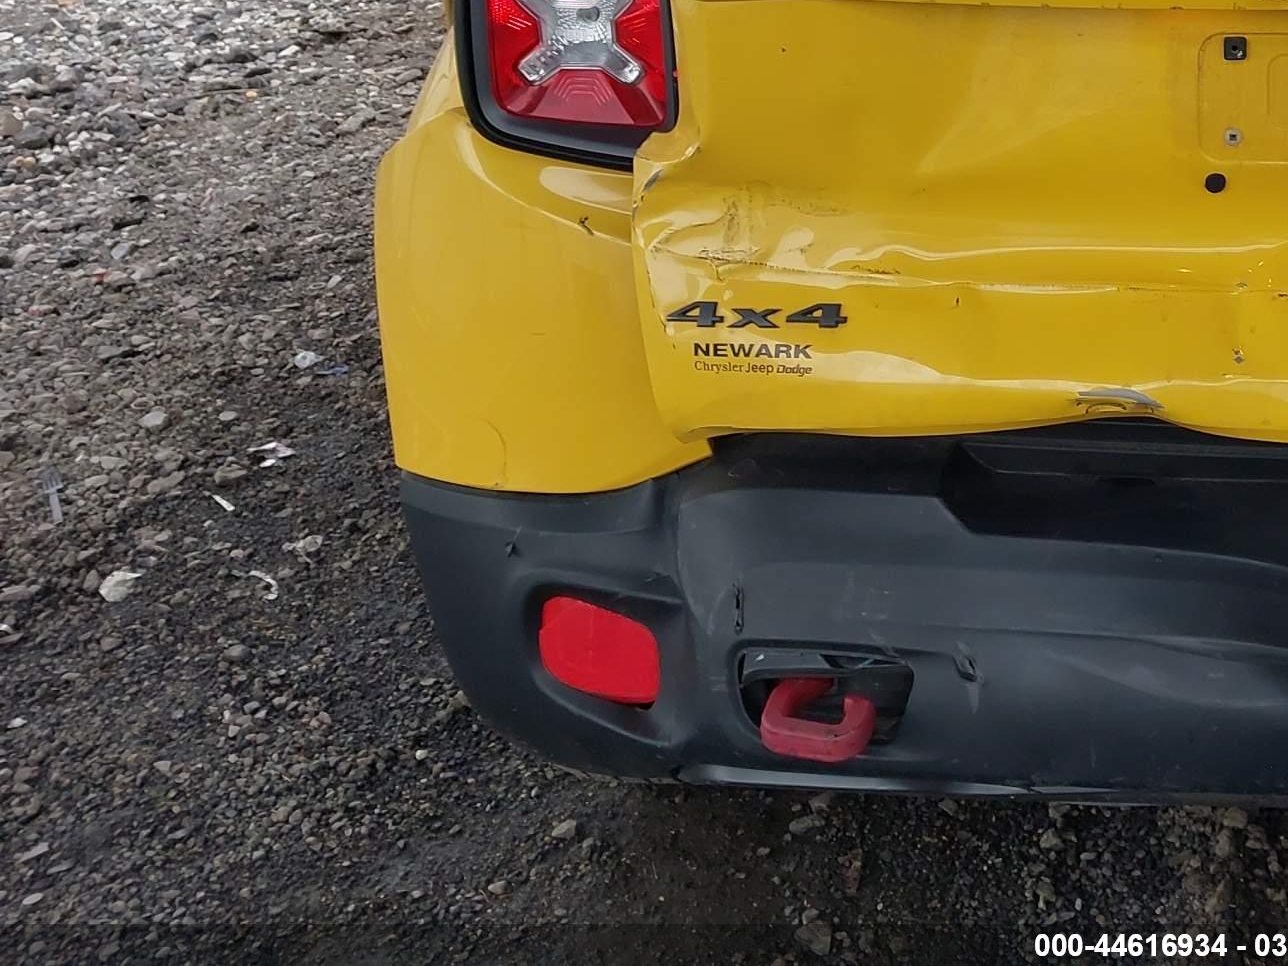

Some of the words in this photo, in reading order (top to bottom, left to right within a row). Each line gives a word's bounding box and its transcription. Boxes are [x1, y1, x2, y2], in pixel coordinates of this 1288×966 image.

[666, 301, 848, 328] 4x4
[693, 343, 813, 359] NEWARK
[694, 361, 744, 373] Chrysler
[745, 362, 774, 376] Jeep
[776, 364, 813, 377] Dodge
